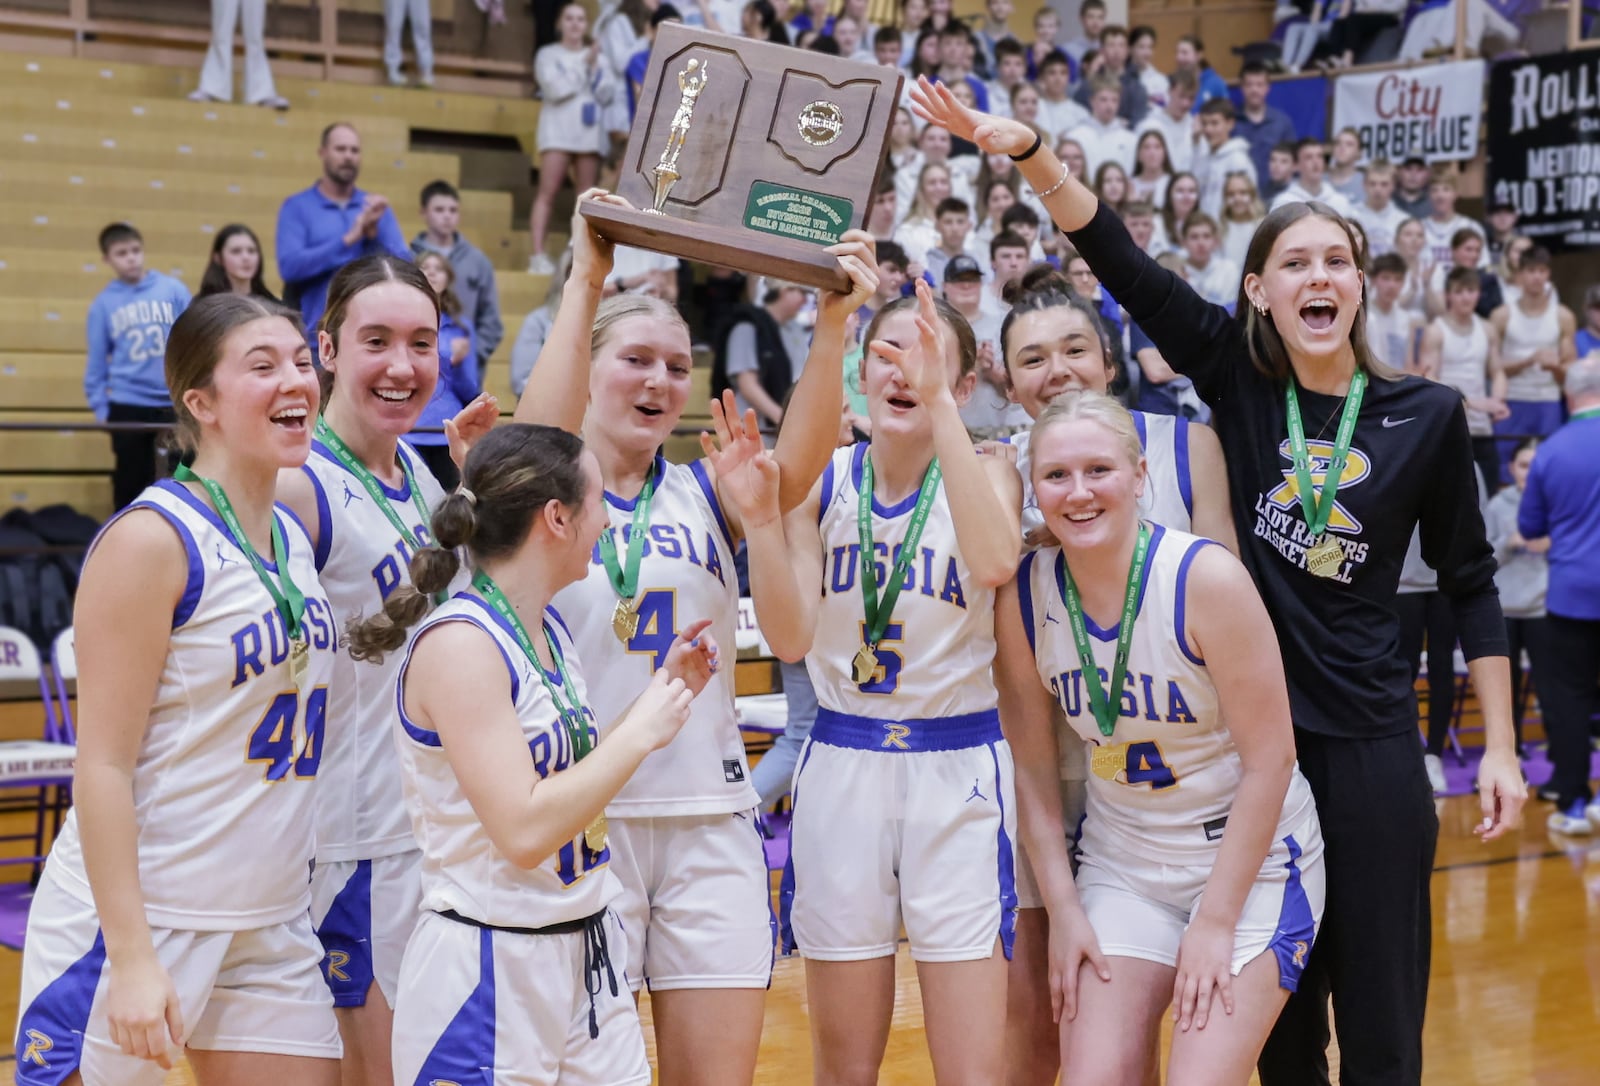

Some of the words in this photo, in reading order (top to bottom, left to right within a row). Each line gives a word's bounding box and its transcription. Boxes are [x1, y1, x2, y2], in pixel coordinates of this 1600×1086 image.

[1375, 75, 1441, 129] City
[1510, 64, 1600, 134] ROLL
[1358, 115, 1472, 160] ARBEQUE
[750, 215, 779, 231] GIRLS
[778, 222, 838, 244] BASKETBALL
[766, 208, 812, 226] DIVISION
[111, 300, 176, 340] JORDAN
[127, 324, 167, 361] 23
[1254, 515, 1352, 585] BASKETL
[1255, 492, 1294, 535] LADY
[1291, 519, 1370, 564] RARS
[821, 542, 968, 611] USSIA
[1310, 550, 1342, 571] OHSAA
[625, 587, 684, 677] 4
[858, 620, 905, 695] 5
[244, 684, 329, 784] 40
[880, 723, 912, 750] R
[325, 950, 352, 982] R
[22, 1029, 54, 1069] R
